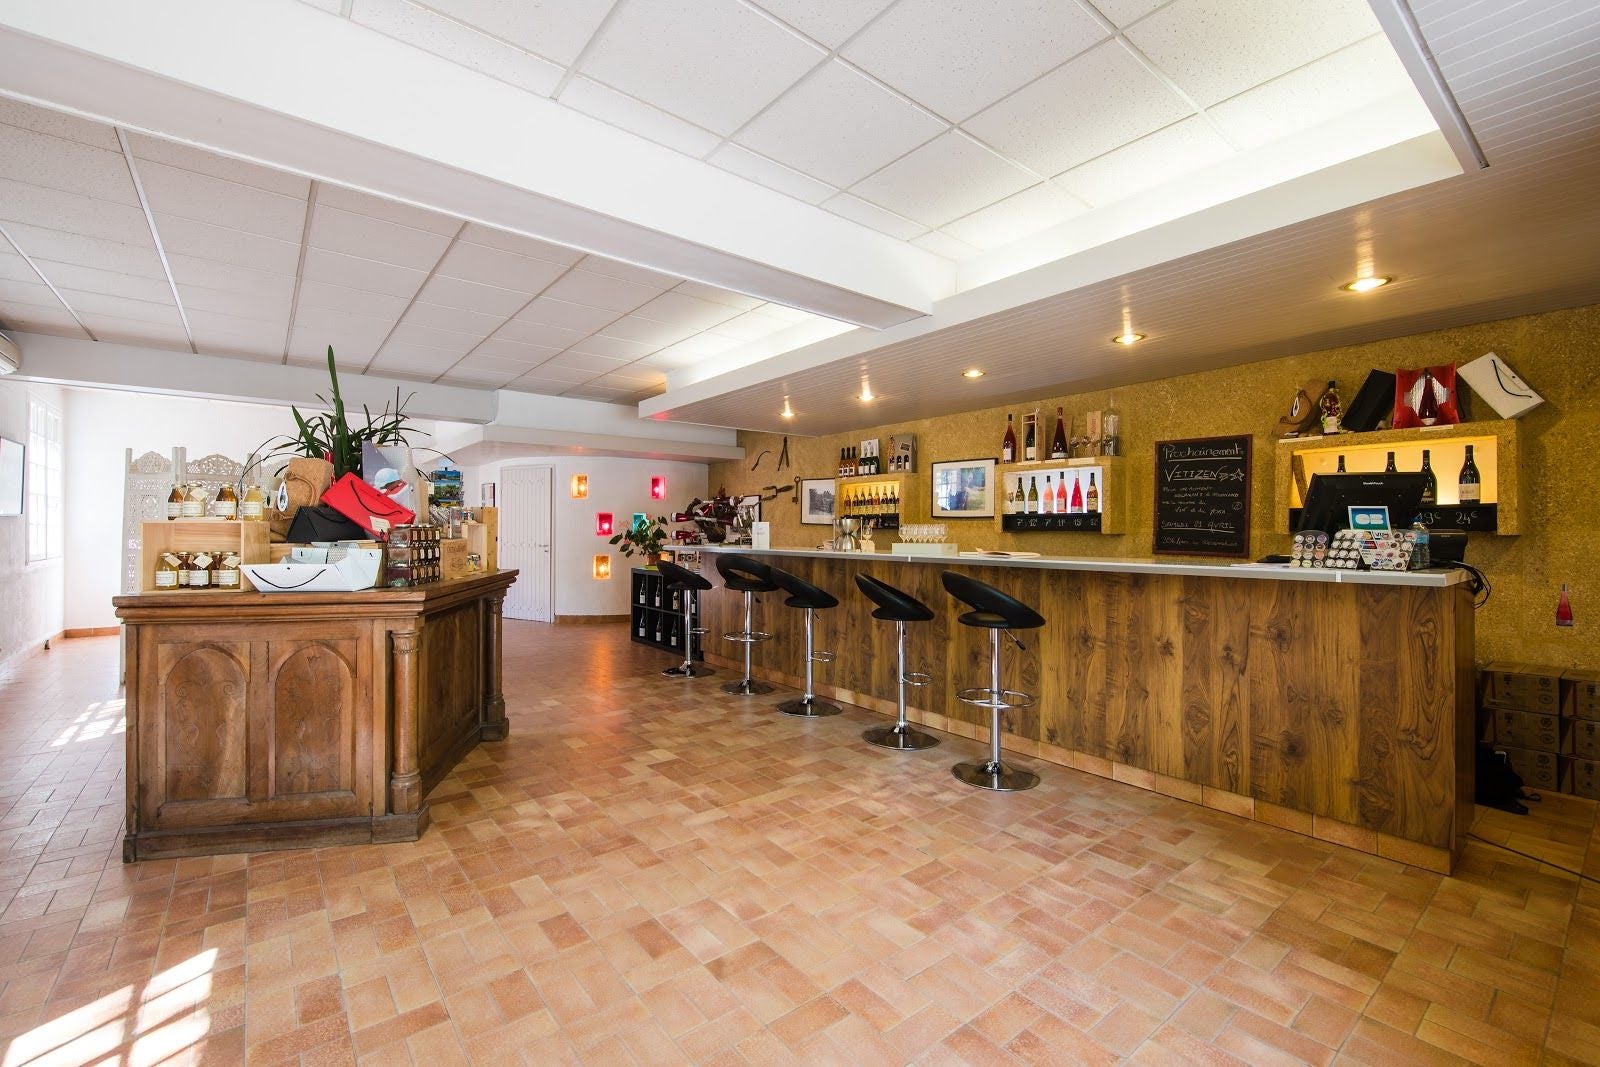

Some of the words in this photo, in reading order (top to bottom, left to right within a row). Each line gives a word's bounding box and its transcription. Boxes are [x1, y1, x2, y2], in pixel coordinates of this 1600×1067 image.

[1163, 442, 1241, 459] Prochainement
[1355, 513, 1384, 525] CB
[1456, 510, 1480, 525] 24€
